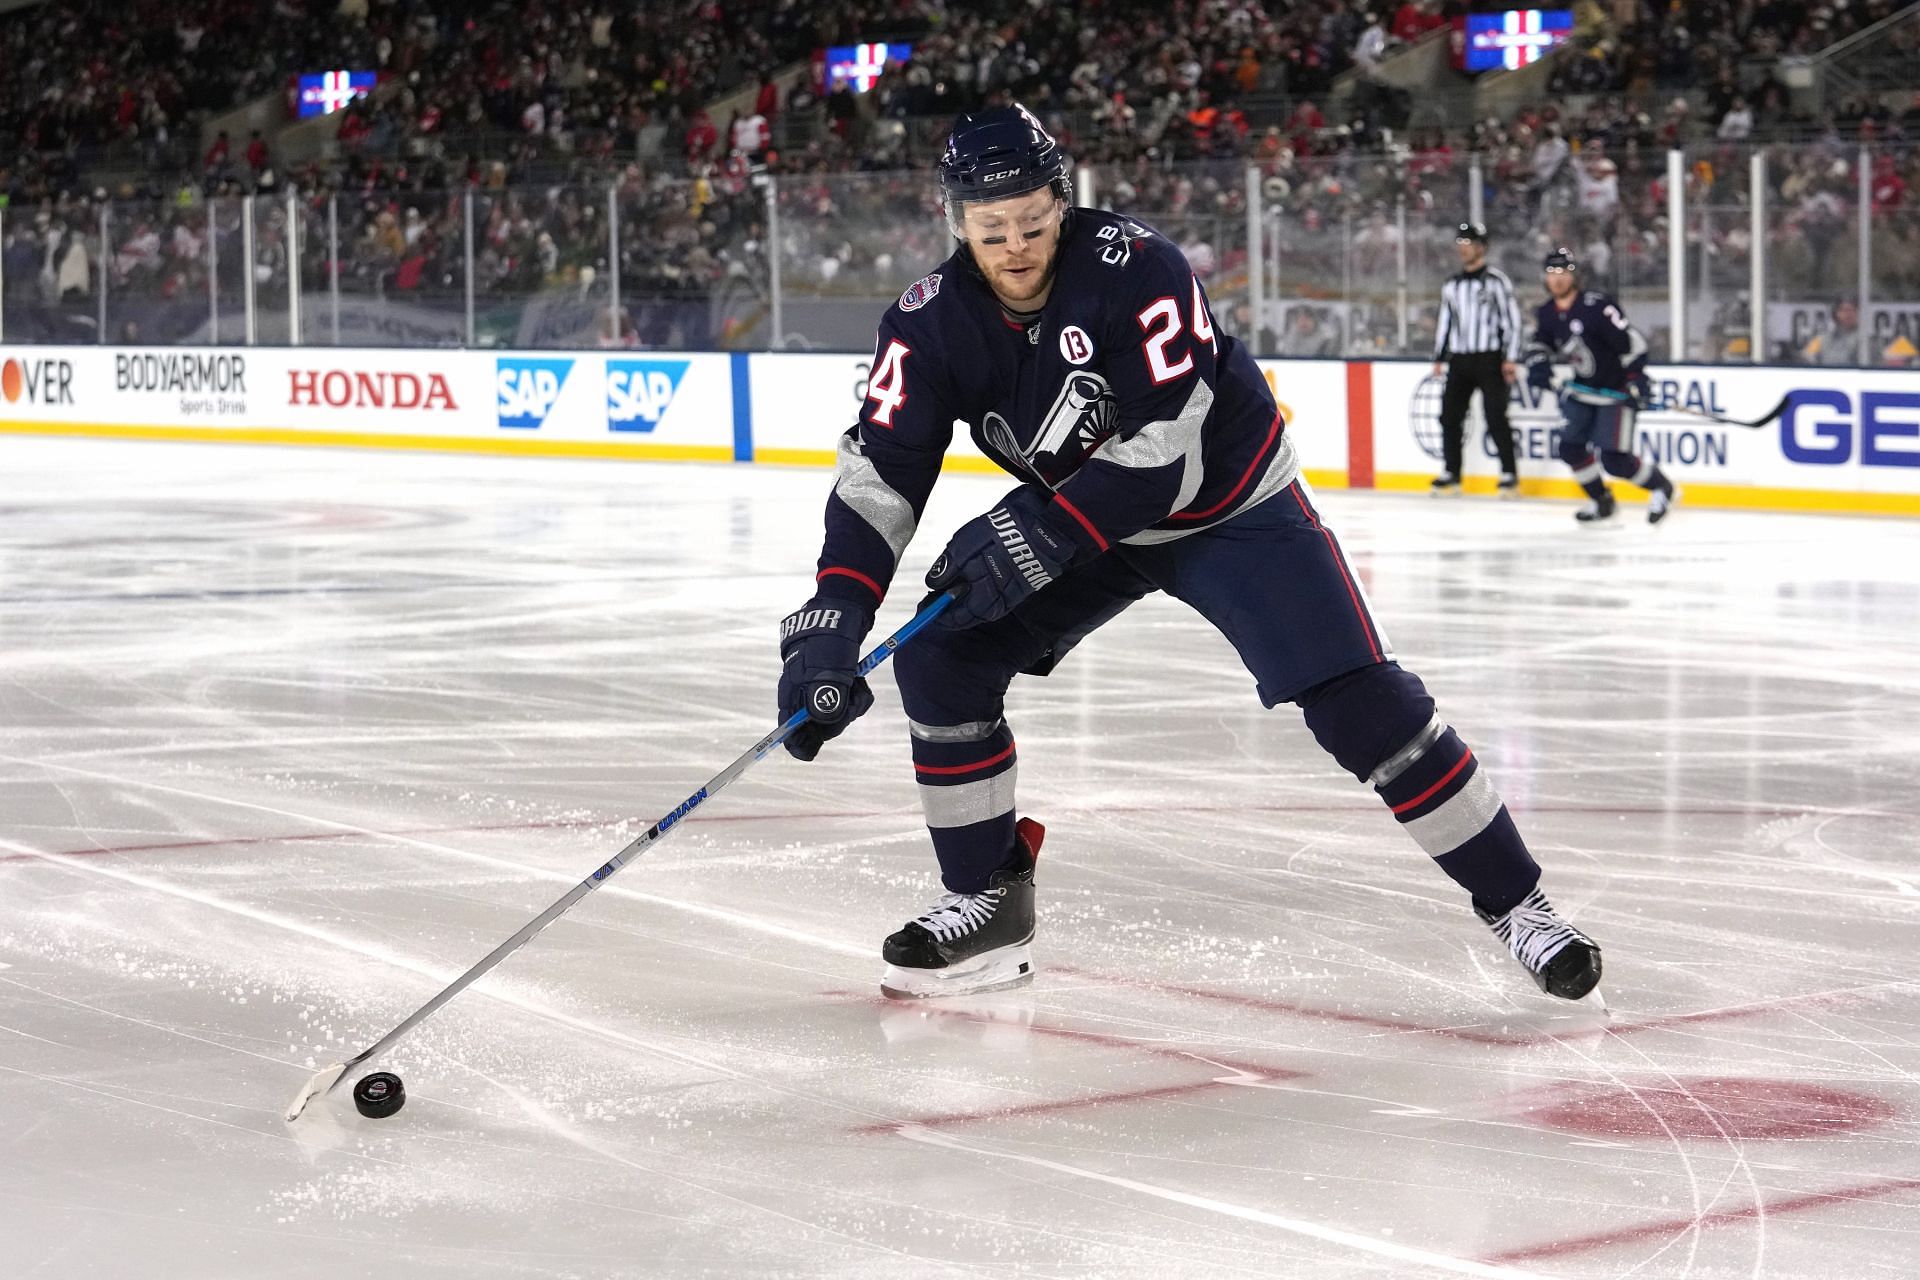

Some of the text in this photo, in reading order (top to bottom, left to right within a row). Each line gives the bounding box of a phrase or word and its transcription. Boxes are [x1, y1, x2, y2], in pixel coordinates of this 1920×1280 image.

[983, 168, 1021, 182] CCM
[1064, 330, 1089, 361] 13
[116, 353, 247, 393] BODYARMOR
[288, 370, 459, 411] HONDA
[497, 368, 558, 418] SAP
[867, 336, 912, 430] 4
[608, 371, 673, 422] SAP
[1640, 431, 1727, 466] NION
[658, 786, 709, 833] NOVIUM
